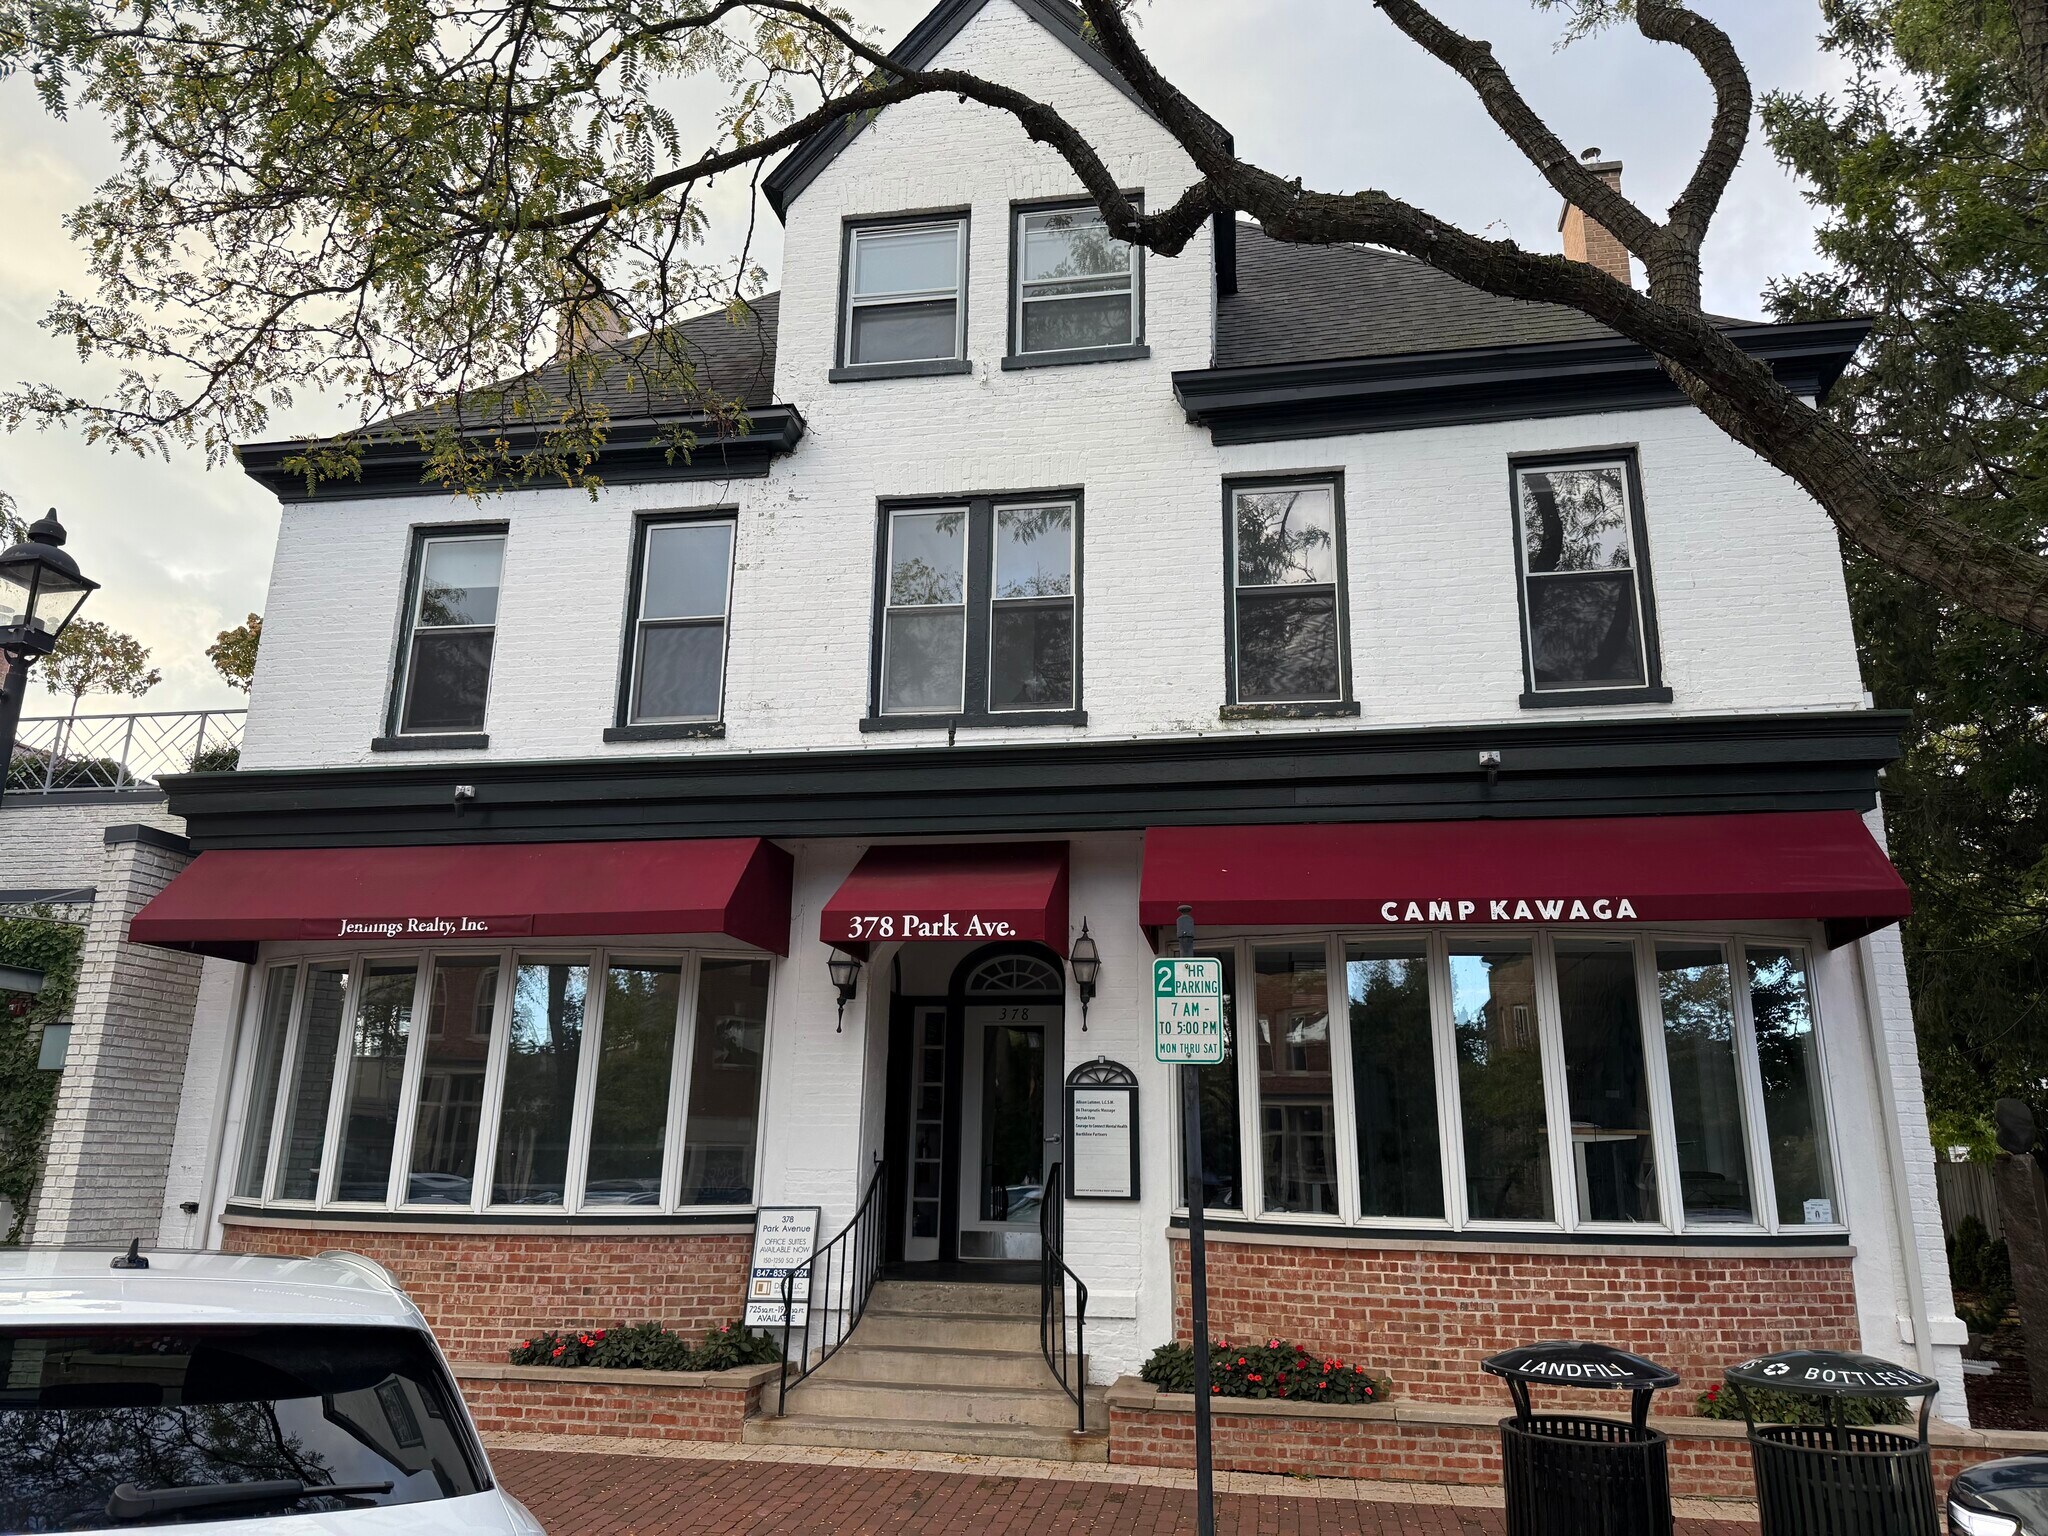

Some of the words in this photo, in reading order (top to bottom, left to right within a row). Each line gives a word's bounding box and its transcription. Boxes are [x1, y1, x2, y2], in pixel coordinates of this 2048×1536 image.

[1381, 900, 1476, 921] CAMP
[1489, 898, 1638, 920] KAWAGA
[406, 917, 456, 935] Realty,
[460, 917, 488, 931] Inc.
[848, 916, 894, 938] 378
[901, 913, 959, 937] Park
[964, 914, 1016, 937] Ave.
[1157, 966, 1172, 991] 2
[1188, 965, 1204, 977] HR
[1175, 980, 1218, 993] PARKING
[999, 1007, 1030, 1020] 378
[1171, 1002, 1178, 1016] 7
[1183, 1002, 1199, 1016] AM
[1159, 1022, 1171, 1034] TO
[1177, 1022, 1199, 1034] 5:00
[1203, 1022, 1217, 1034] PM
[1160, 1043, 1177, 1053] MON
[1180, 1043, 1200, 1054] THRU
[1203, 1043, 1217, 1053] SAT
[1518, 1359, 1634, 1377] LANDFILL
[1804, 1367, 1909, 1386] BOTTLES
